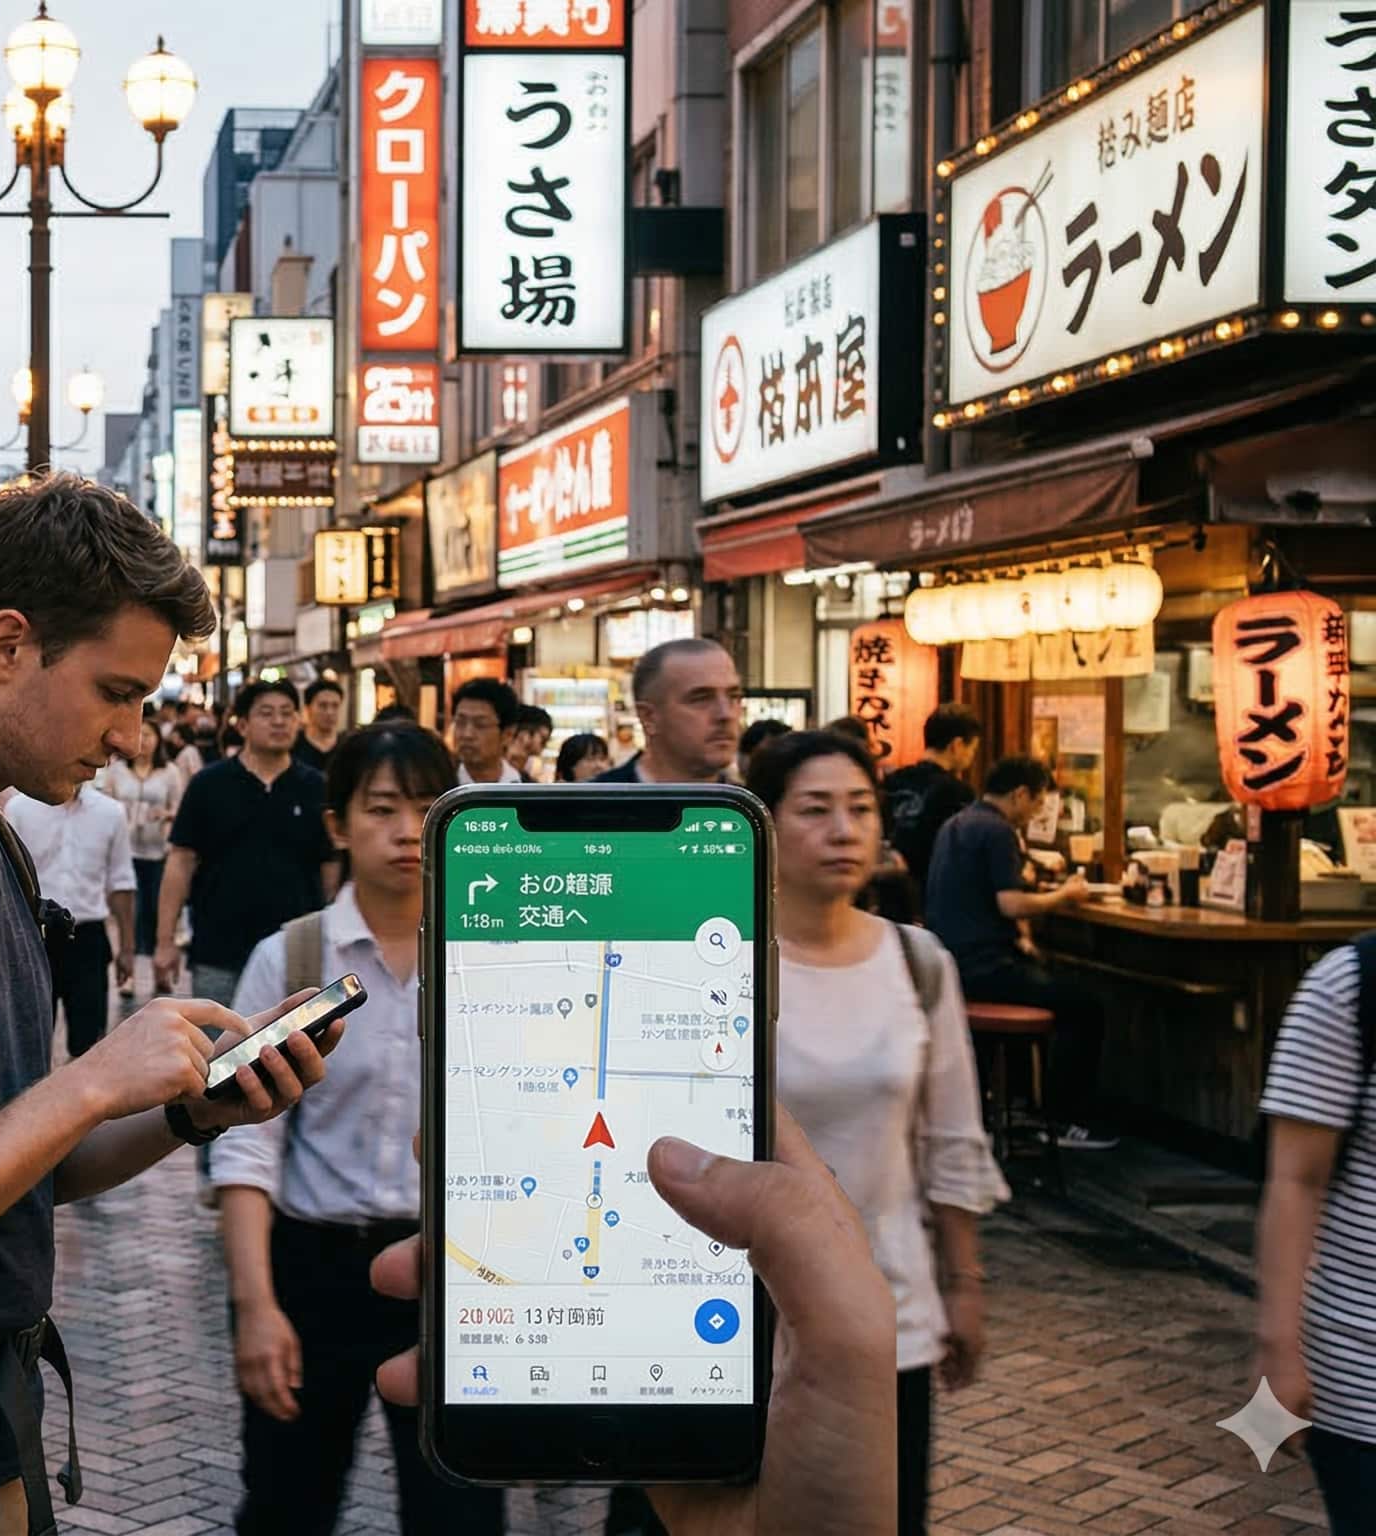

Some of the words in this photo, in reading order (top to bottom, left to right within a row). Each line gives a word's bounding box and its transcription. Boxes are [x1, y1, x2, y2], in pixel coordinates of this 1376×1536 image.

[374, 70, 430, 337] クローパン
[501, 80, 576, 329] うさ場
[1062, 146, 1249, 335] ラーメン
[1234, 615, 1306, 791] ラーメン
[518, 904, 589, 928] 交通へ
